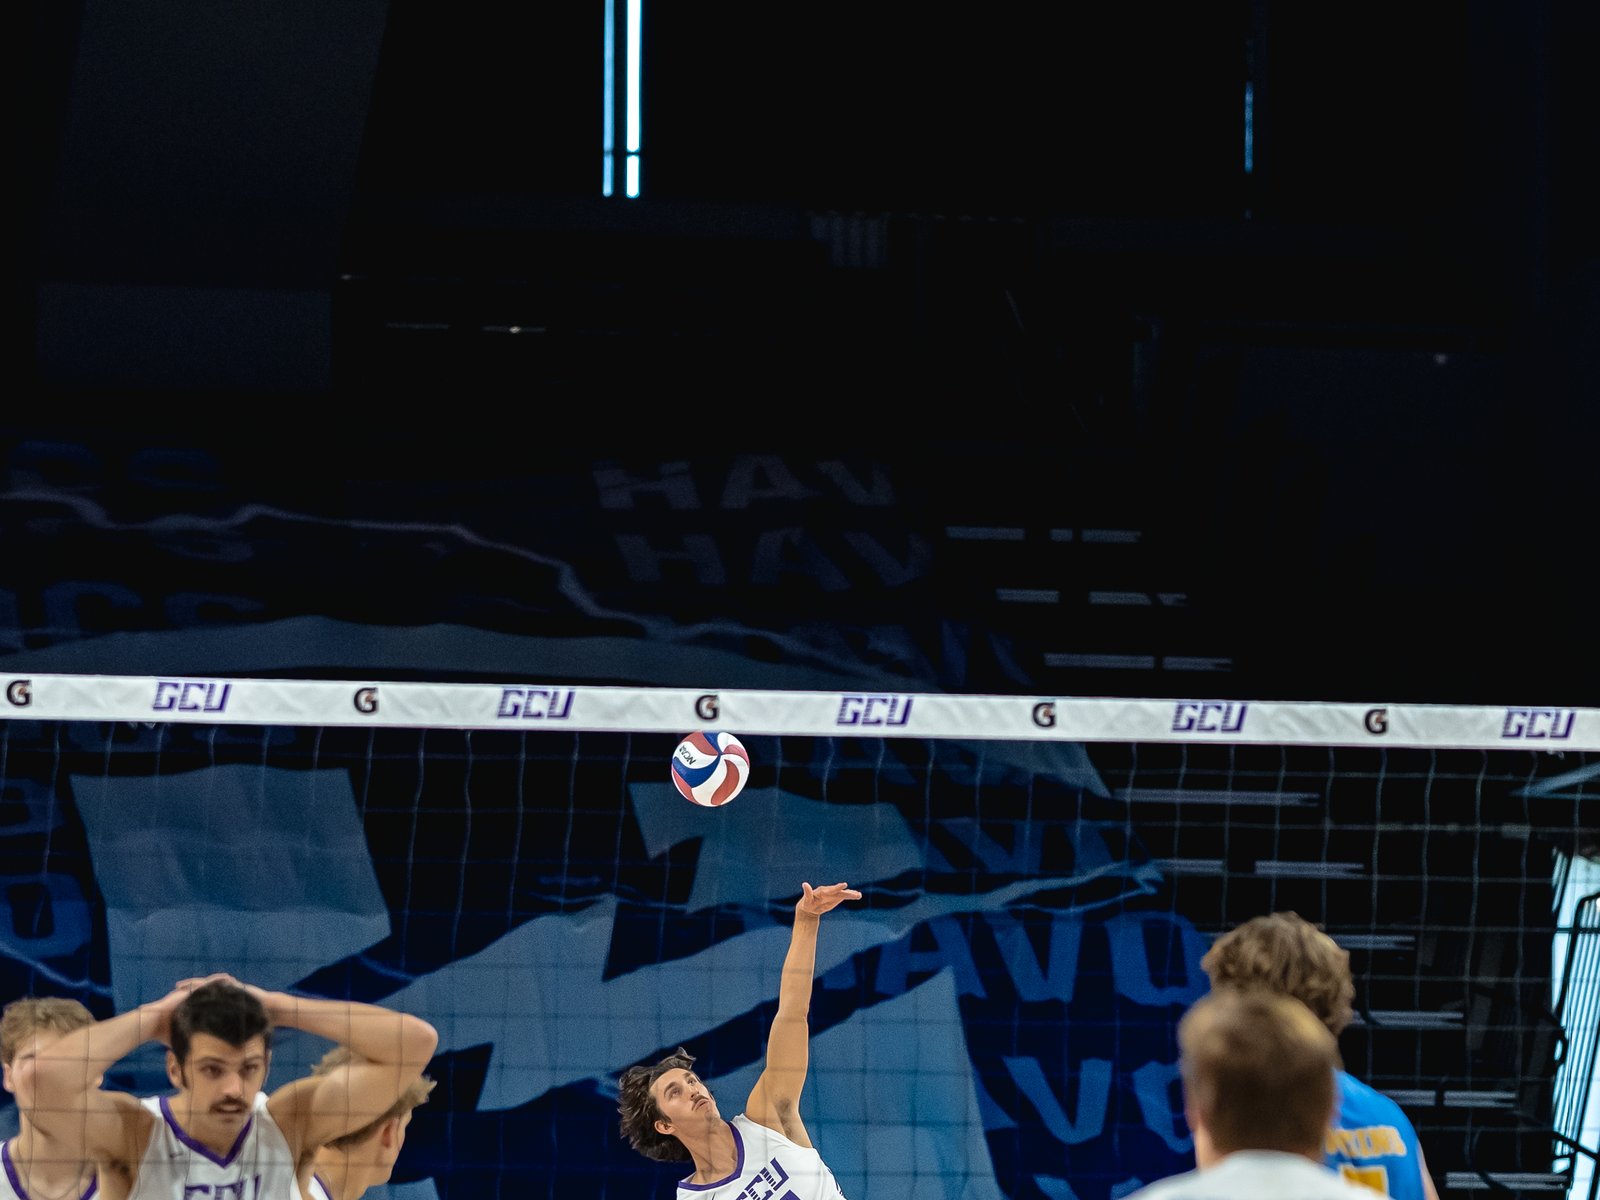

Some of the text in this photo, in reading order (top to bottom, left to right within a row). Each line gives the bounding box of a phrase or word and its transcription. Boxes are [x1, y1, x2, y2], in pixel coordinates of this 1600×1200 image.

[152, 681, 232, 712] GCU
[497, 686, 575, 719] GCU
[836, 695, 913, 727] GCU
[1171, 701, 1250, 733] GCU
[1501, 708, 1577, 740] GCU
